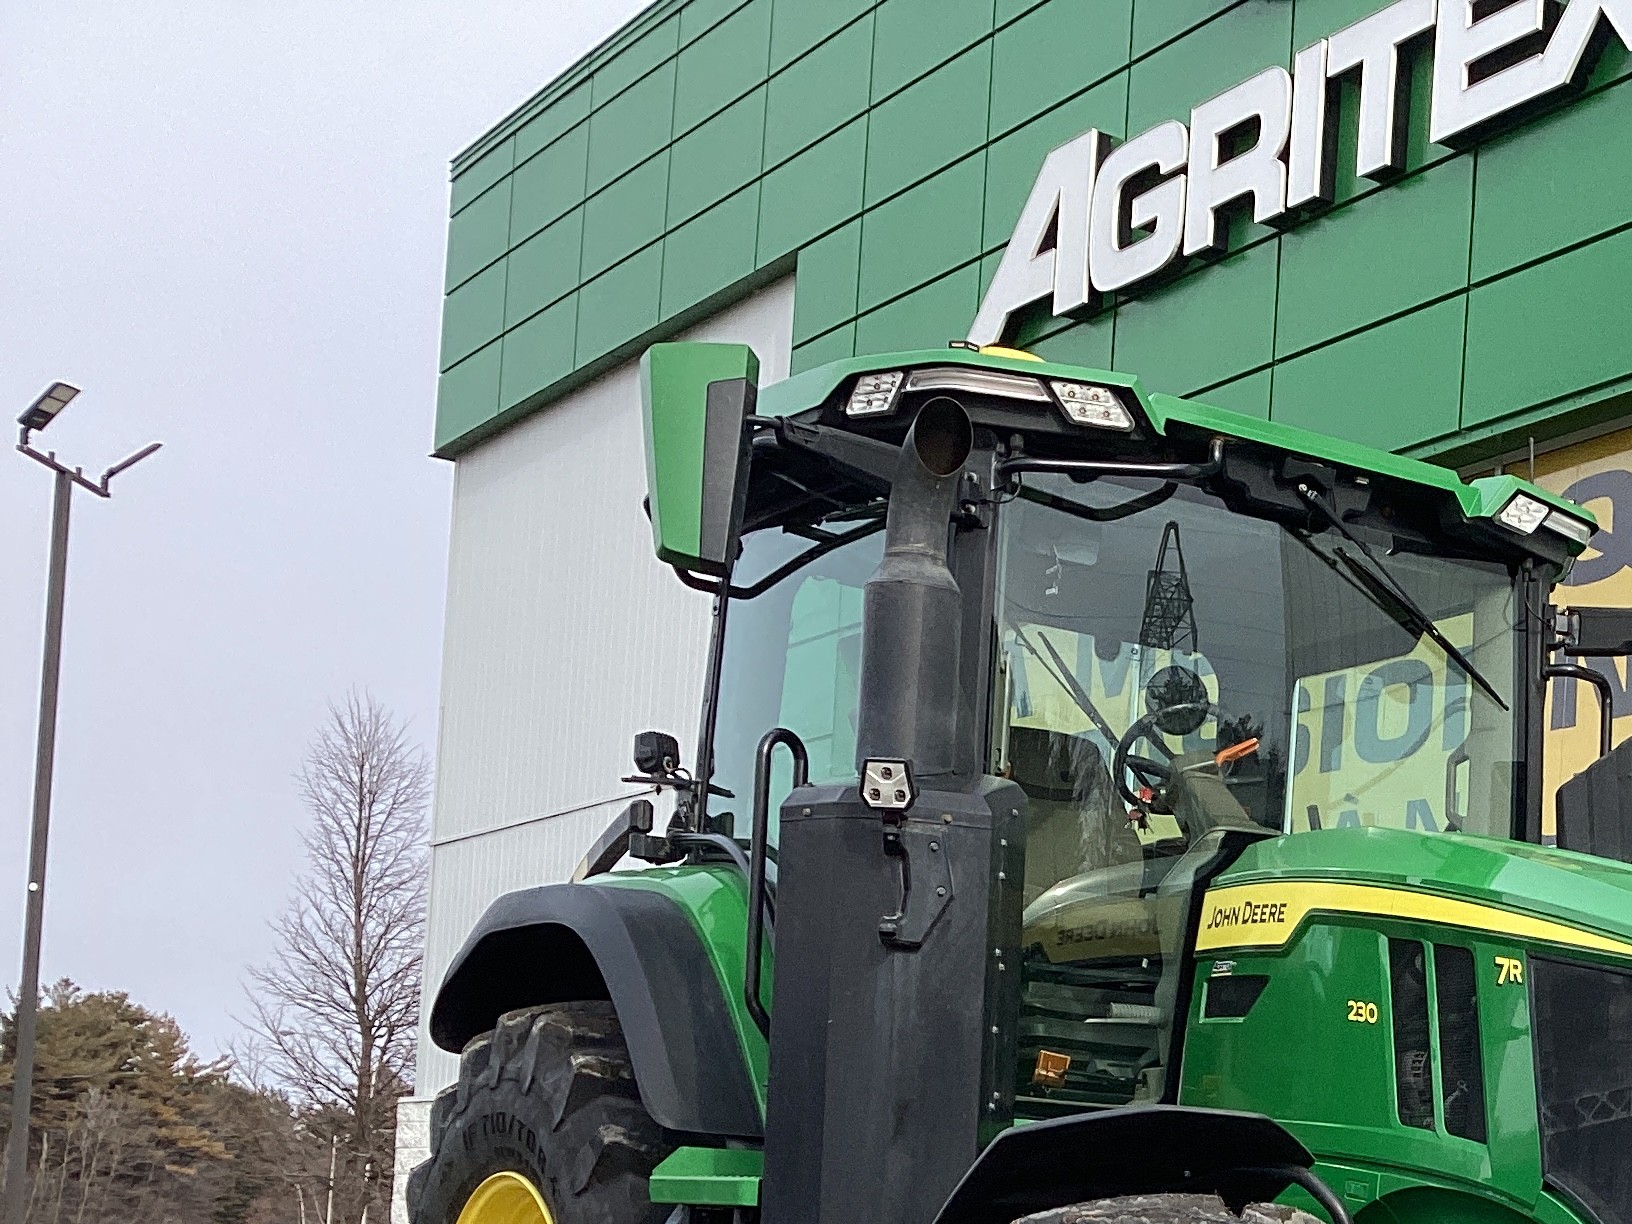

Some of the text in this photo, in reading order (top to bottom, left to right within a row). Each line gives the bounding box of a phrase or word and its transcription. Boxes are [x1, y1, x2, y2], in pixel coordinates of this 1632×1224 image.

[1207, 900, 1288, 930] JOHN DEERE
[1494, 955, 1523, 985] 7R
[1347, 999, 1378, 1024] 230
